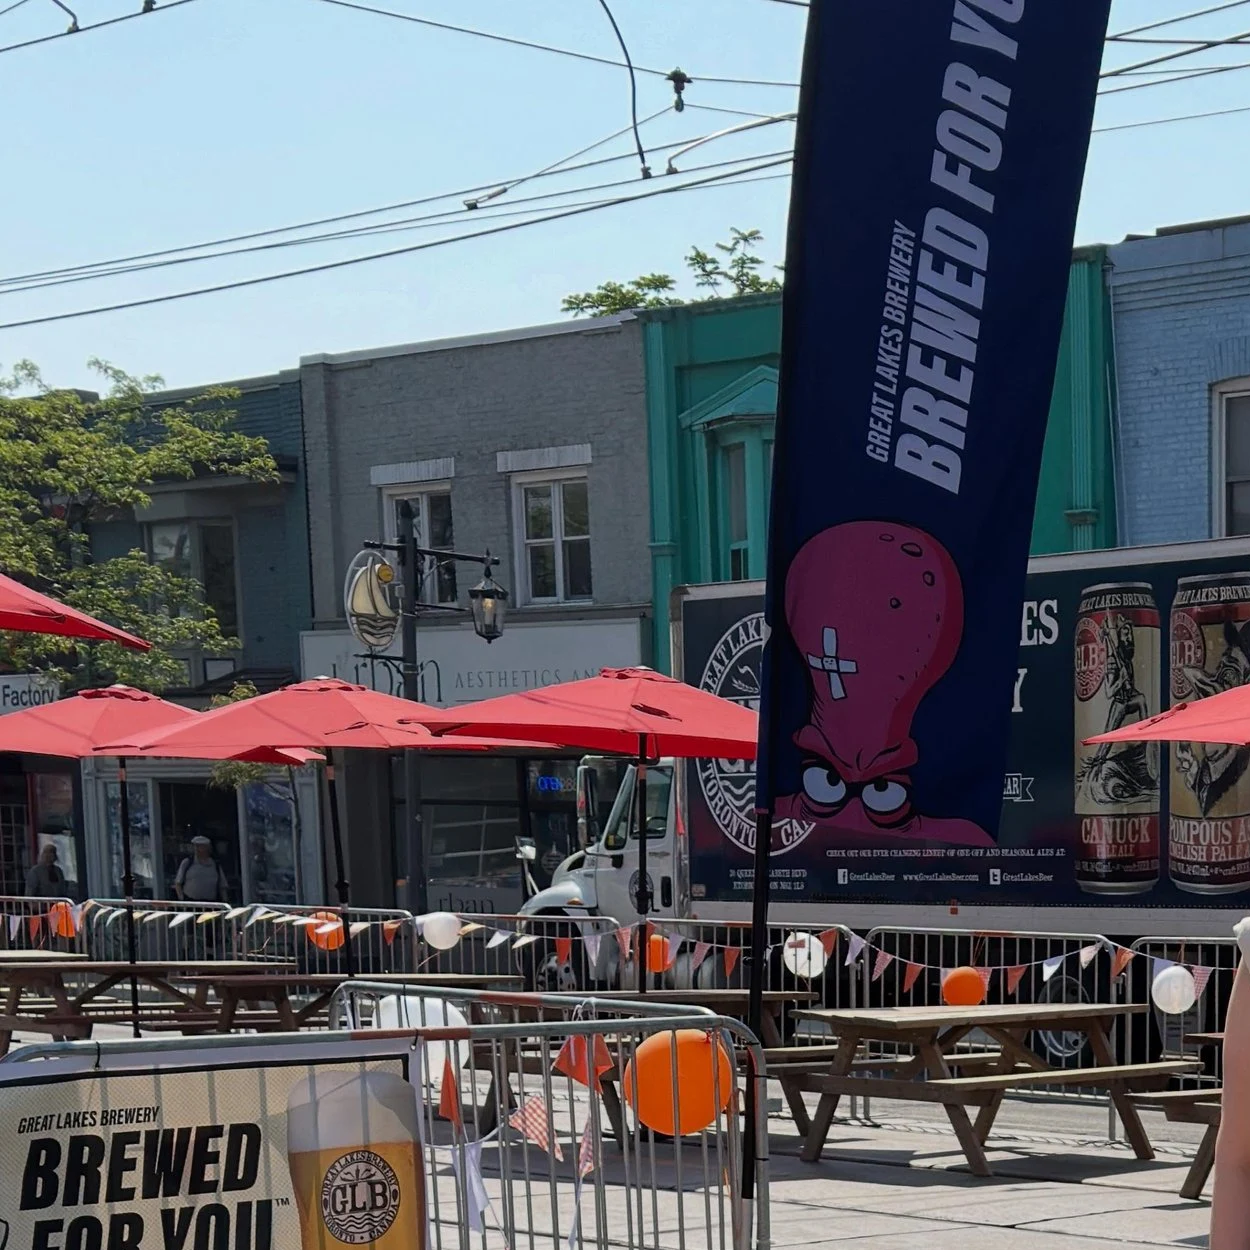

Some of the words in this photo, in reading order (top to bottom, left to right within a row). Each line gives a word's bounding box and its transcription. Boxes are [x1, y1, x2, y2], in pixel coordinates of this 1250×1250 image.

[930, 61, 1012, 214] FOR
[882, 219, 916, 326] BREWERY
[875, 323, 904, 397] LAKES
[894, 207, 990, 495] BREWED
[865, 395, 895, 463] GREAT
[1096, 594, 1122, 609] LAKES
[1191, 587, 1219, 602] LAKES
[455, 668, 562, 688] AESTHETICS
[2, 683, 55, 706] Factory
[1081, 816, 1151, 844] CANUCK
[1169, 816, 1233, 846] POMPOUS
[826, 850, 847, 858] CHECK
[986, 849, 1000, 857] AND
[1001, 849, 1036, 857] SEASONAL
[1036, 849, 1054, 857] ALES
[1118, 844, 1135, 858] ALE
[1212, 844, 1243, 861] PALE
[850, 872, 895, 882] GreatLakesBeer
[902, 872, 979, 882] www.GreatLakesBeer.com
[1002, 872, 1053, 882] GreatLakesBeer
[18, 1114, 56, 1134] GREAT
[56, 1110, 97, 1131] LAKES
[100, 1106, 160, 1127] BREWERY
[19, 1122, 262, 1211] BREWED
[331, 1180, 389, 1215] GLB
[369, 1204, 398, 1239] CANADA
